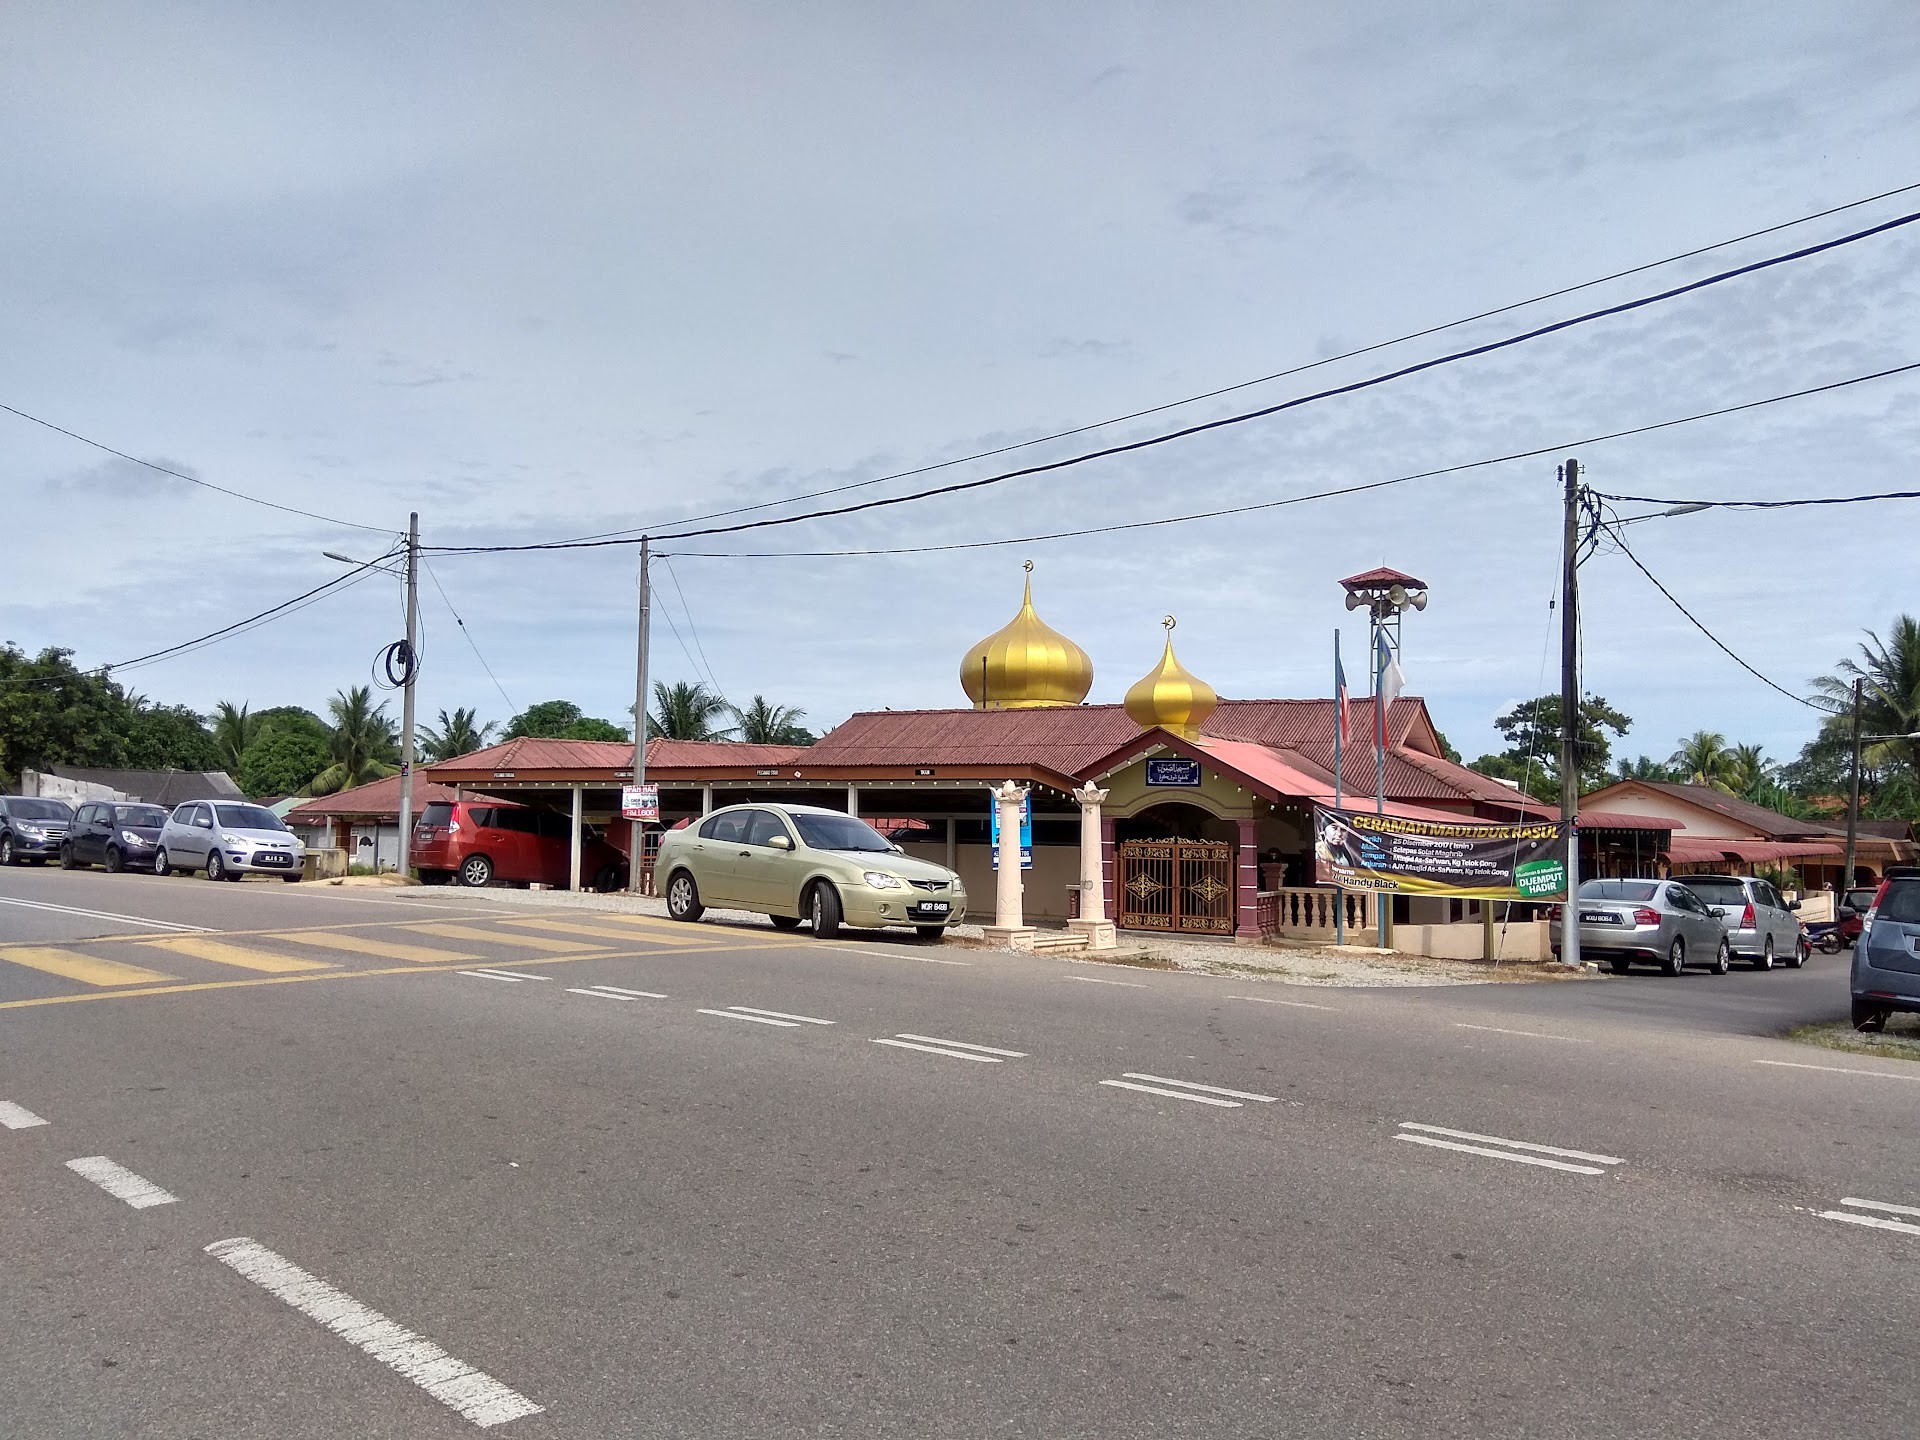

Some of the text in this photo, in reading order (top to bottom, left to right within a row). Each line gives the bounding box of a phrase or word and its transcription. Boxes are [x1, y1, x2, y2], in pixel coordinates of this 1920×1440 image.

[1352, 815, 1559, 839] CERAMAH MAULIDUR RASUL
[1433, 841, 1451, 849] 2017
[1392, 846, 1417, 855] Selepas
[1434, 850, 1464, 858] Maghrib
[1361, 851, 1386, 860] Tempat
[1451, 859, 1461, 867] Kg
[1461, 859, 1480, 867] Telok
[1479, 860, 1497, 868] Gong
[1331, 864, 1355, 876] bersama
[1360, 860, 1388, 869] Anjuran
[1391, 862, 1405, 870] AJK
[1404, 863, 1427, 873] Masjid
[1464, 868, 1474, 876] Kg
[1474, 868, 1491, 876] Telok
[1490, 869, 1510, 877] Gong
[1343, 876, 1373, 889] Handy
[1374, 879, 1399, 889] Black
[1519, 872, 1563, 887] DIJEMPUT
[1528, 881, 1557, 894] HADIR
